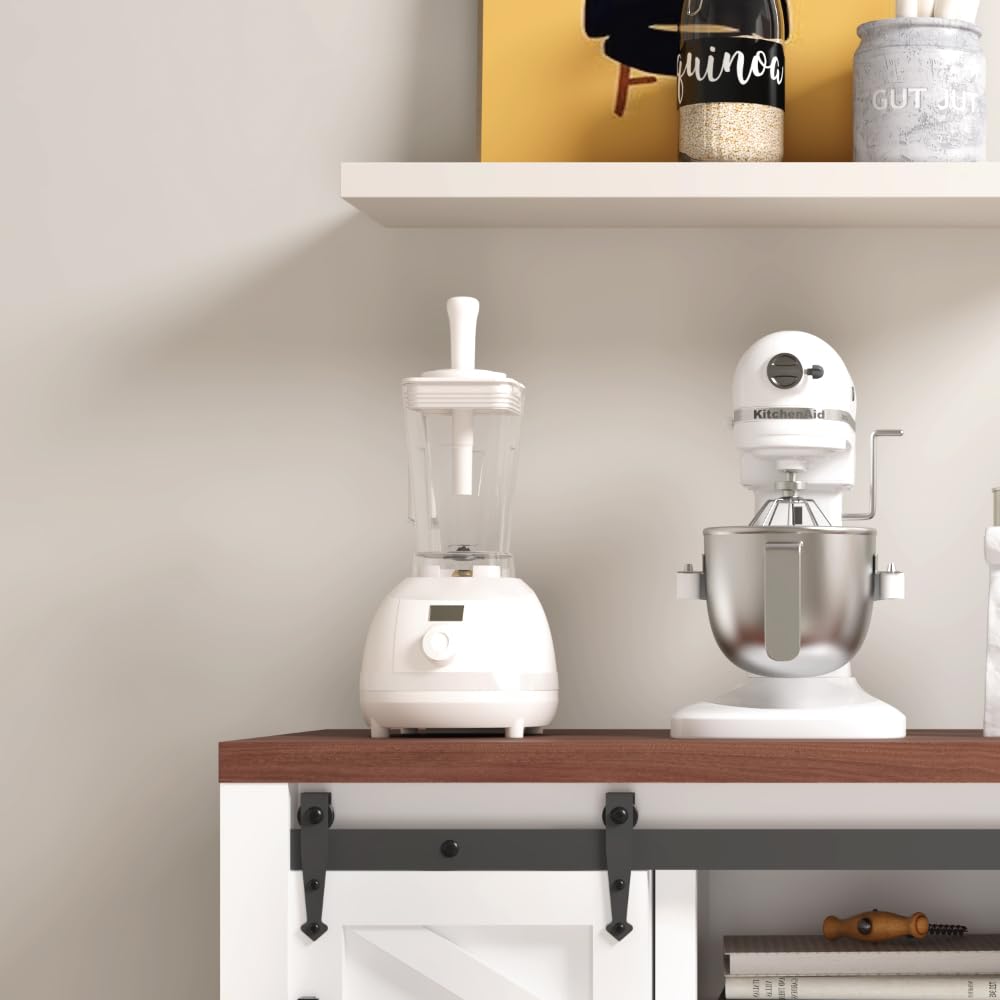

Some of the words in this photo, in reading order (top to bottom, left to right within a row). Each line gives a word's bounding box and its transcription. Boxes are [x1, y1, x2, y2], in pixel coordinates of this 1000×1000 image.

[677, 45, 784, 105] quinoa
[871, 87, 928, 111] GUT
[753, 409, 825, 420] KitchenAid
